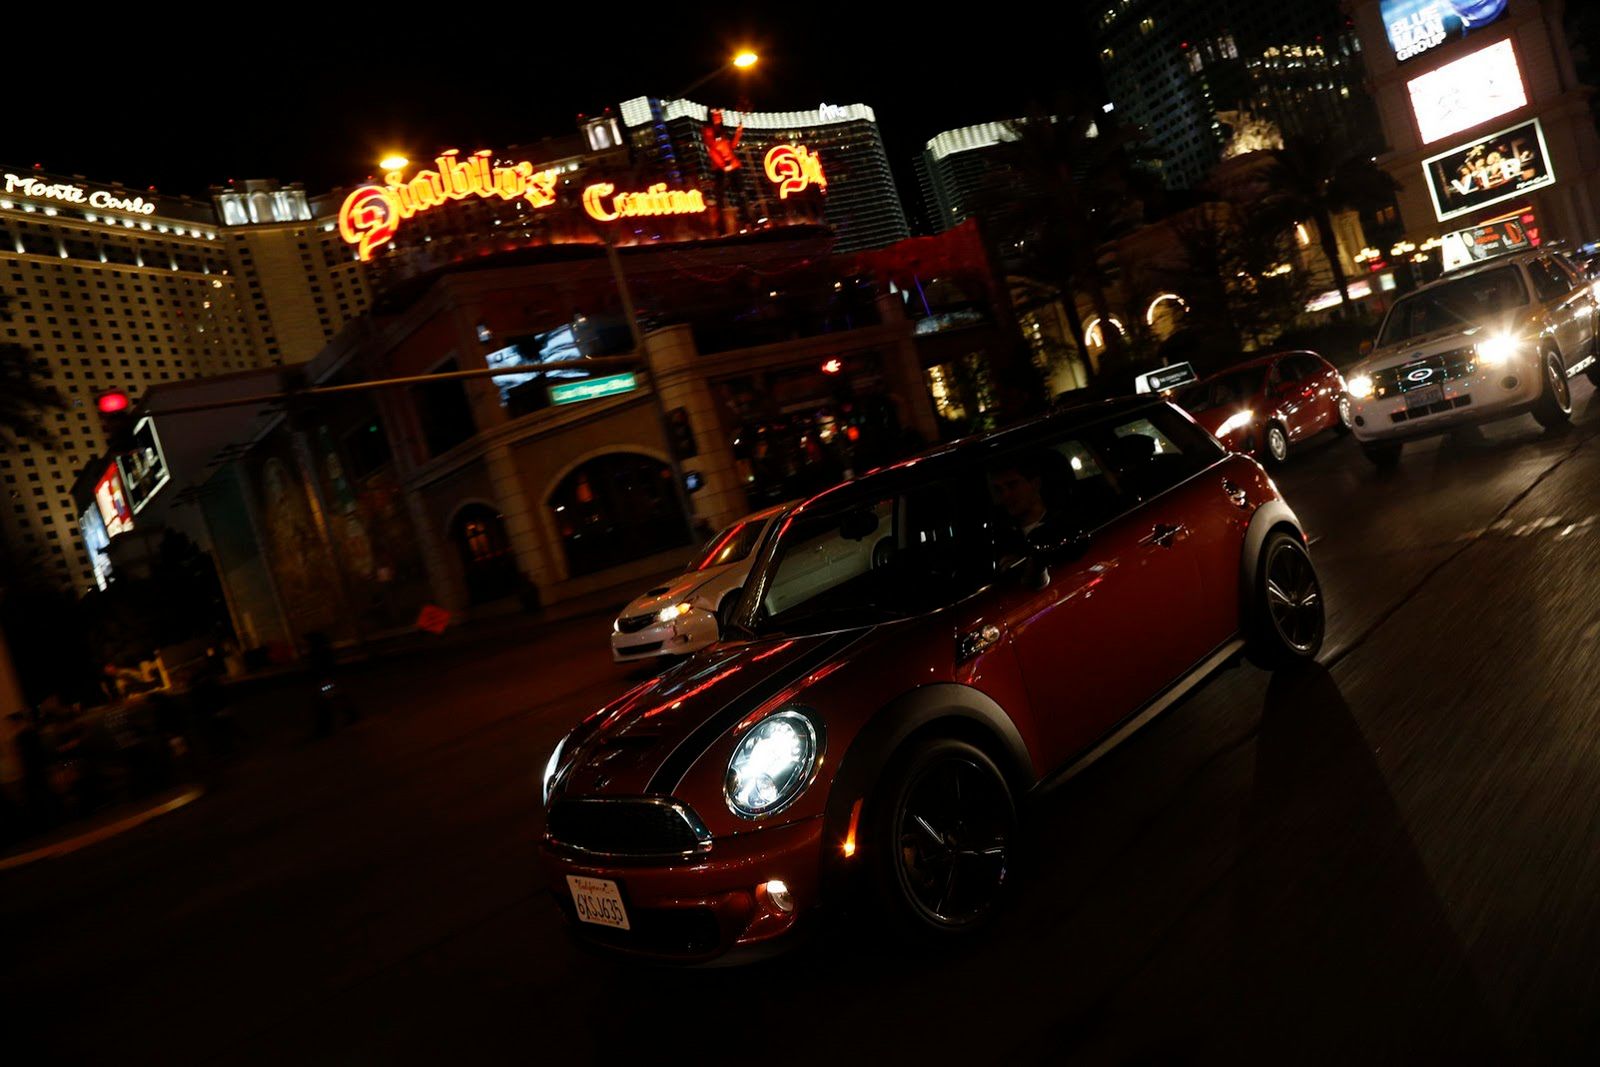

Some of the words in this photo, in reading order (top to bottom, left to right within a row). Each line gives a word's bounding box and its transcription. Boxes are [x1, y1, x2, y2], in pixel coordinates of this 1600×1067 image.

[1396, 31, 1447, 61] GROUP
[4, 173, 88, 203] Monte
[89, 190, 156, 215] Carlo
[339, 149, 557, 261] Diablo's
[582, 182, 706, 221] Cantina
[577, 893, 624, 922] 6XSJ635
